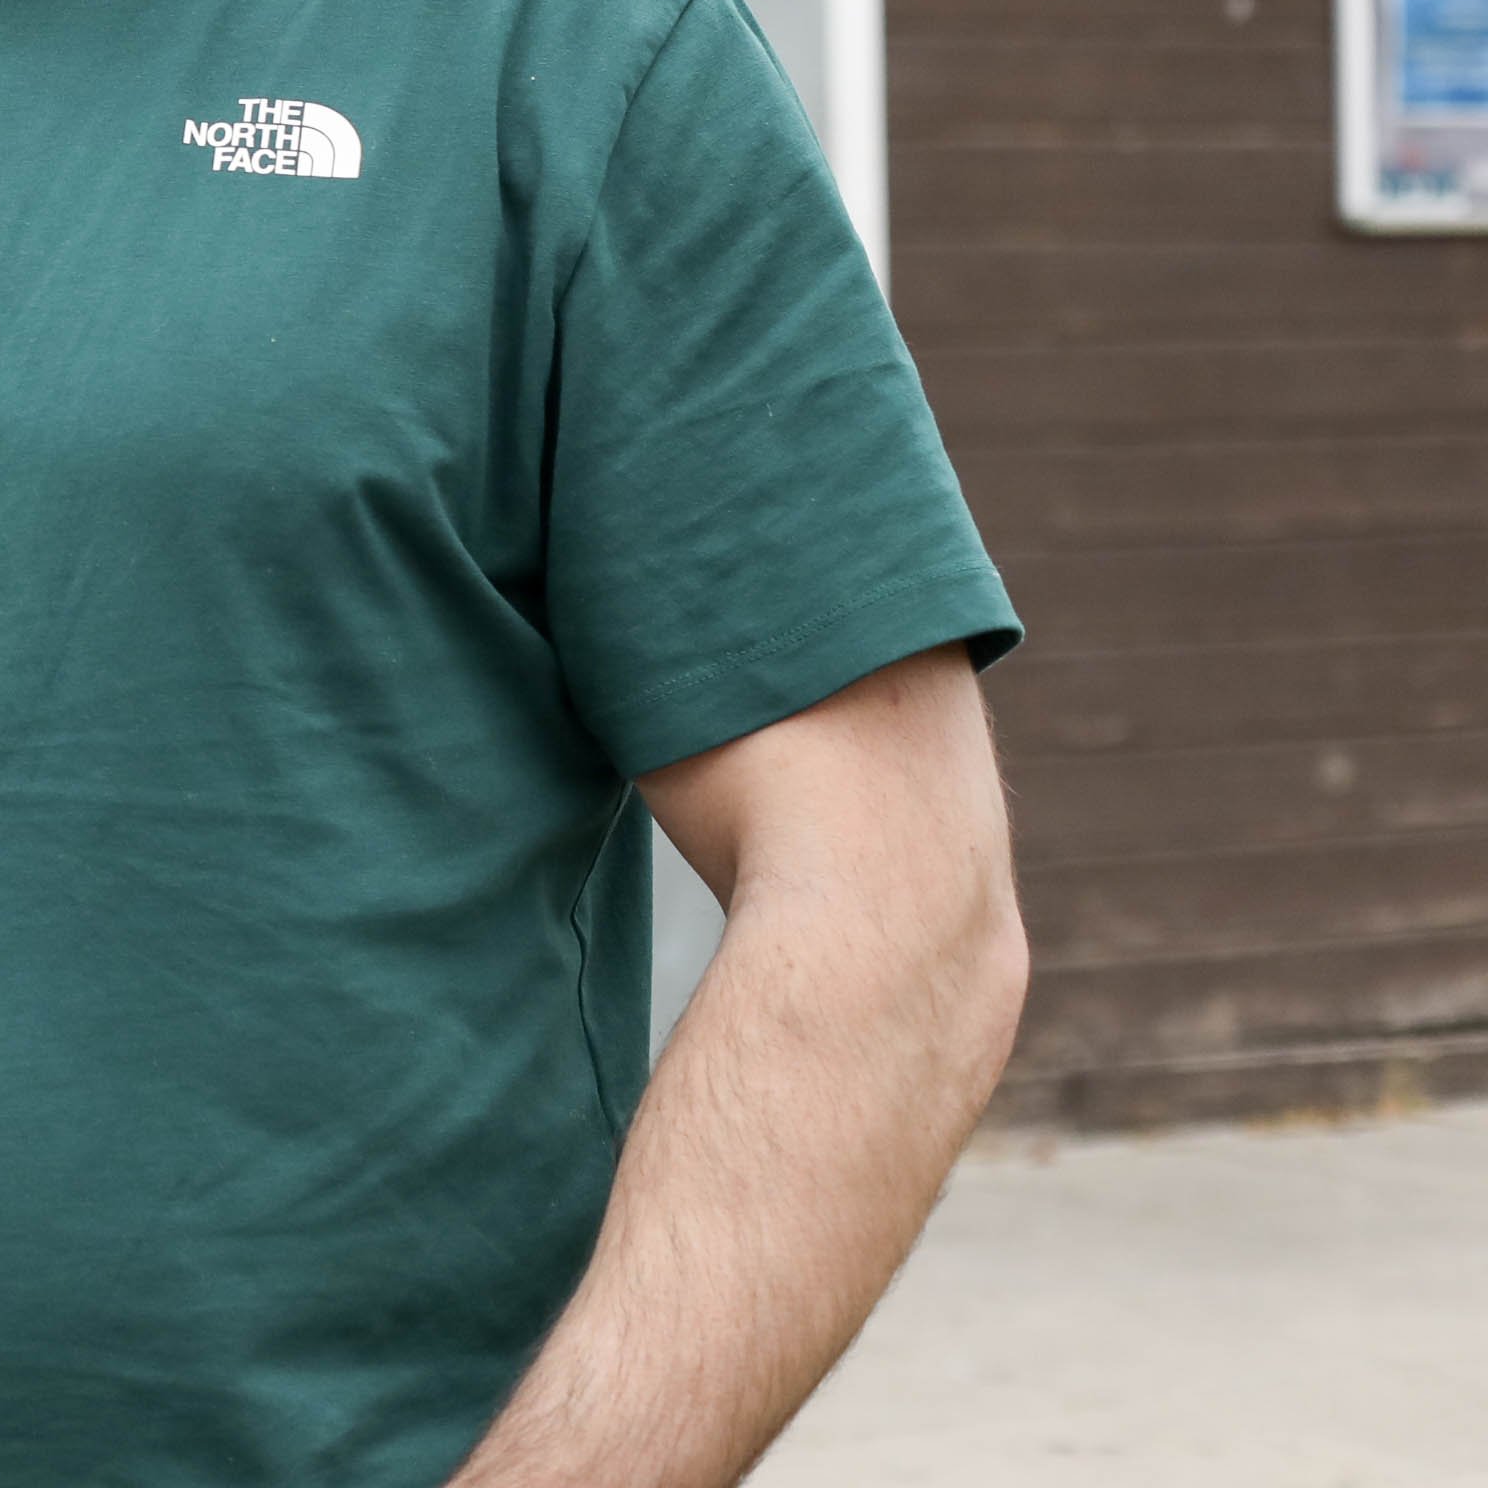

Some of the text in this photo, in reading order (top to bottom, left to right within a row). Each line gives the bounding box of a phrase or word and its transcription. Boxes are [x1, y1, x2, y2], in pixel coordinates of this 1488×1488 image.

[238, 98, 303, 126] THE
[182, 119, 301, 151] NORTH
[212, 146, 299, 175] FACE
